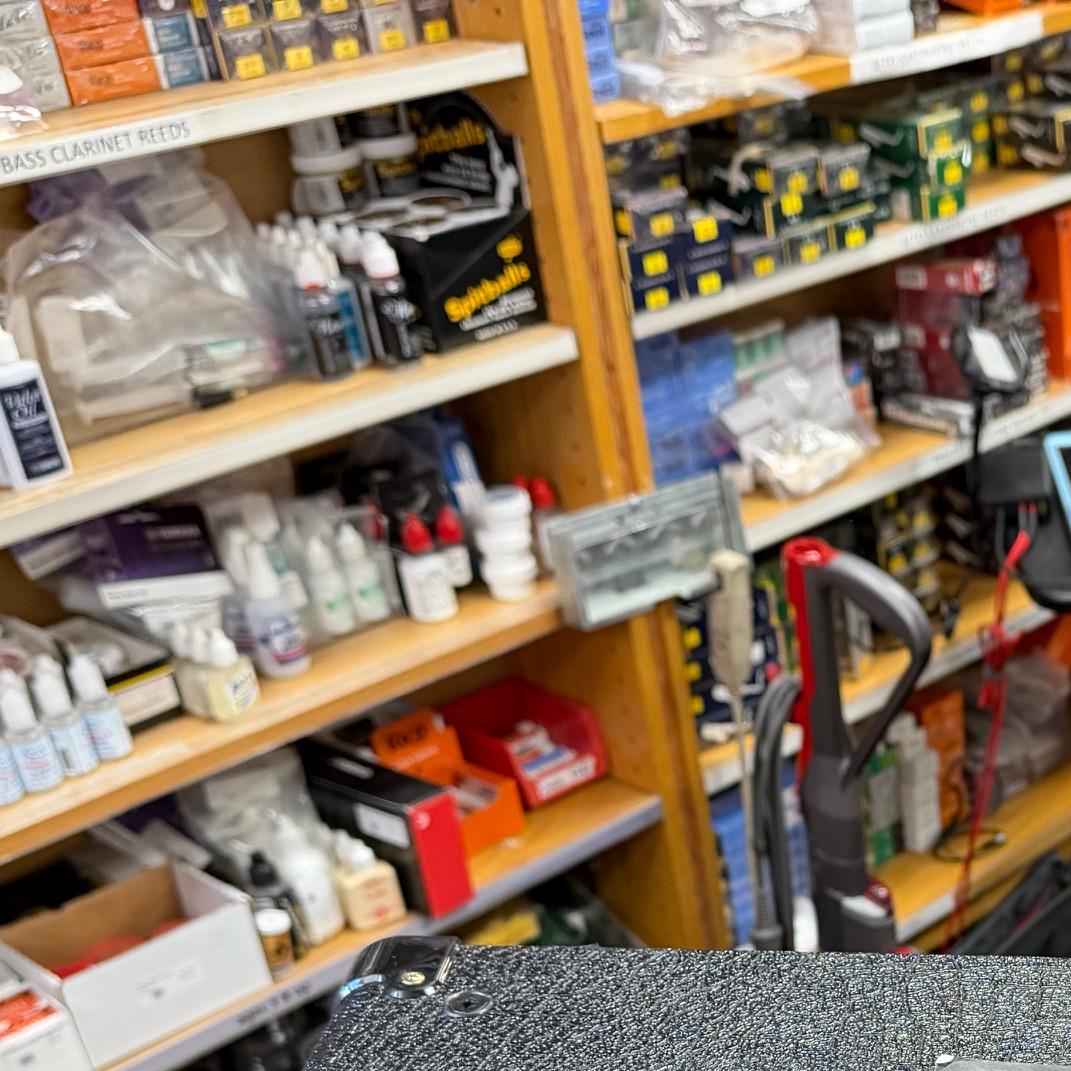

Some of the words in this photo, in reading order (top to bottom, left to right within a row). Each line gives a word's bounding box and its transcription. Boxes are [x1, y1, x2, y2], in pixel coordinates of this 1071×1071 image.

[0, 150, 47, 175] BASS
[50, 133, 133, 164] CLARINET
[138, 120, 191, 146] REEDS
